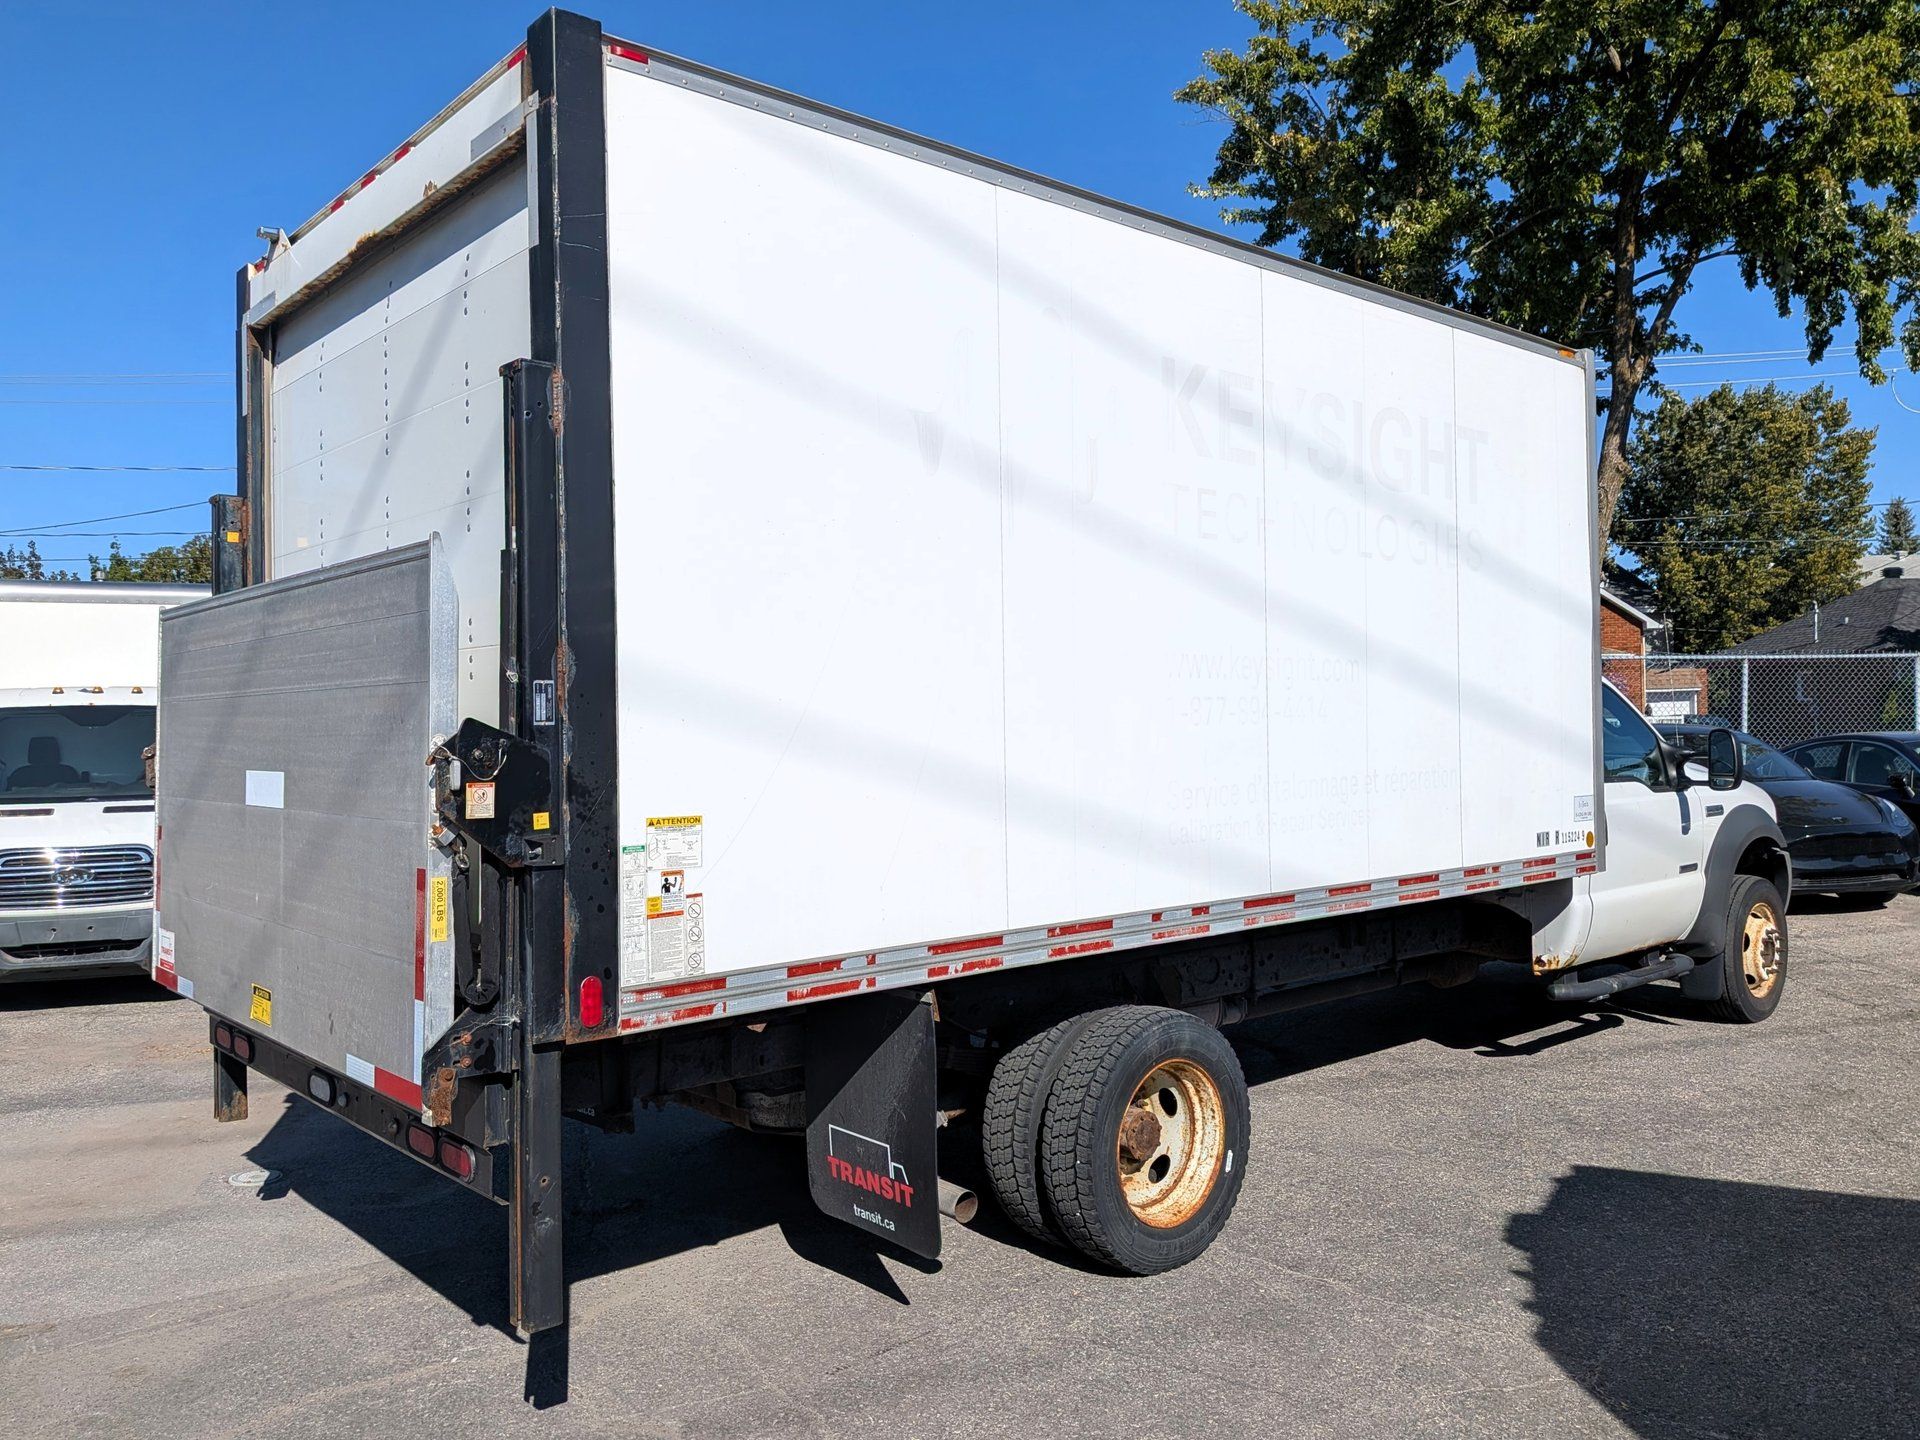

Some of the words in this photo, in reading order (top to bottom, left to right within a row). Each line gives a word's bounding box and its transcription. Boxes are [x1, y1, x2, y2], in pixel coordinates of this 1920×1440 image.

[1160, 356, 1490, 505] KEYSIGHT
[1162, 482, 1484, 572] TECHNOLOGIES
[655, 816, 701, 826] ATTENTION
[436, 880, 444, 903] 2,000
[436, 904, 444, 922] LBS
[826, 1155, 914, 1208] TRANSIT
[853, 1203, 896, 1231] transit.ca
